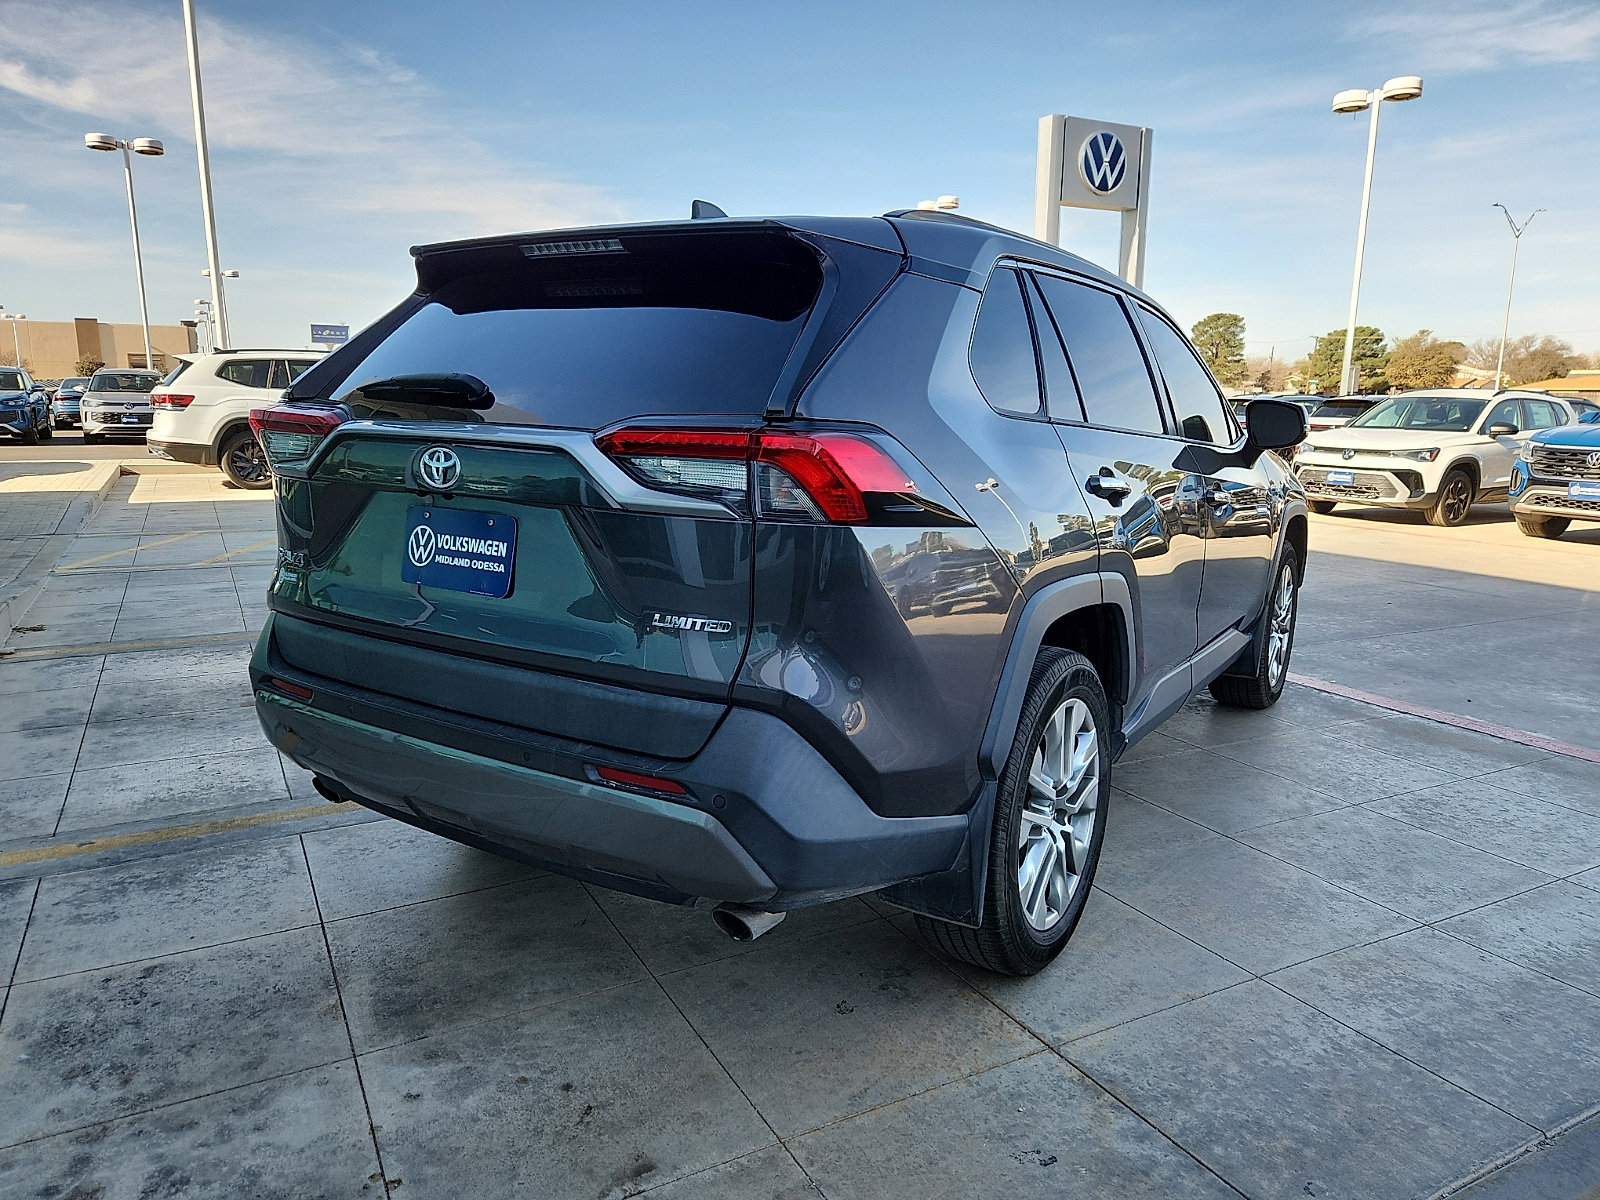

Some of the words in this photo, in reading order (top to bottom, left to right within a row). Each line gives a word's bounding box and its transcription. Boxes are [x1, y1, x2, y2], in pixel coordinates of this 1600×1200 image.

[1080, 131, 1126, 195] VW
[408, 525, 435, 567] VW
[437, 533, 507, 557] VOLKSWAGEN
[435, 554, 470, 567] MIDLAND
[471, 560, 505, 573] ODESSA
[652, 614, 732, 633] LIMITED
